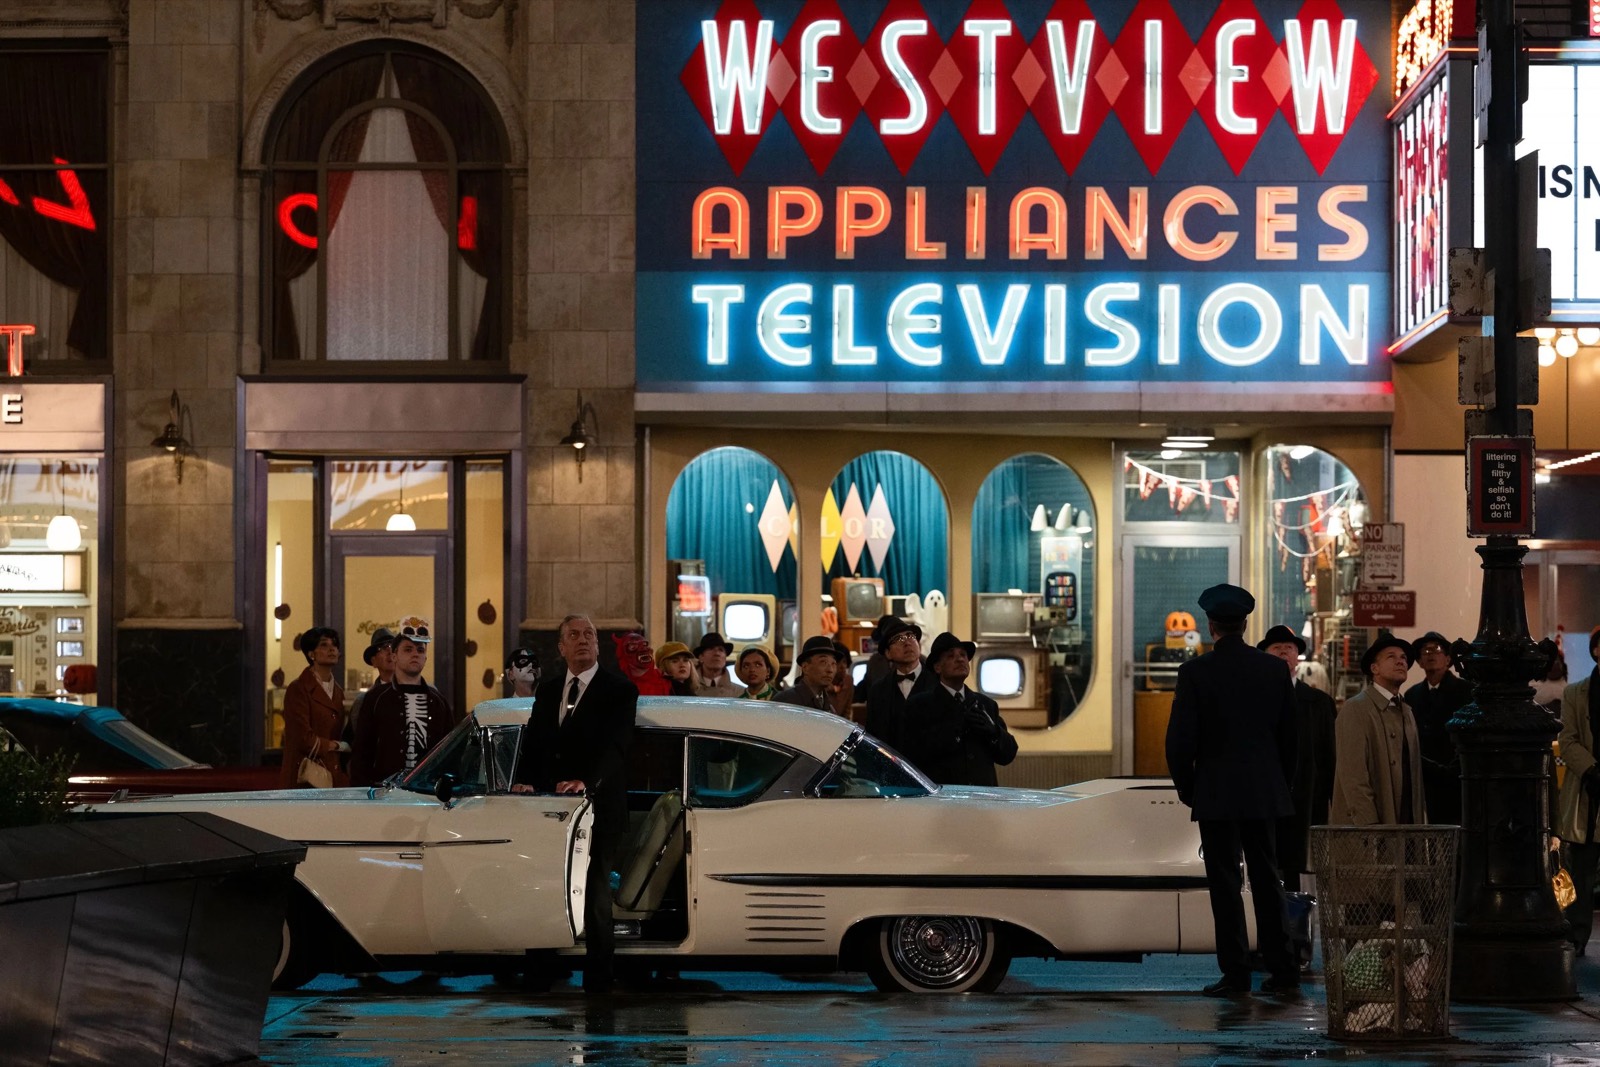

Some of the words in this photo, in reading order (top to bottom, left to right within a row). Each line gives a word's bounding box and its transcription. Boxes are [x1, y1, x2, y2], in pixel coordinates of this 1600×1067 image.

[700, 18, 1358, 136] WESTVIEW
[691, 184, 1369, 262] APPLIANCES
[691, 282, 1370, 367] TELEVISION
[1486, 453, 1517, 462] littering
[1491, 470, 1511, 479] filthy
[1498, 478, 1504, 486] &
[1488, 486, 1514, 494] selfish
[1489, 502, 1511, 510] don't
[1503, 511, 1512, 519] it!
[1364, 525, 1382, 540] NO
[1365, 544, 1402, 553] PARKING
[1358, 593, 1370, 602] NO
[1371, 593, 1410, 602] STANDING
